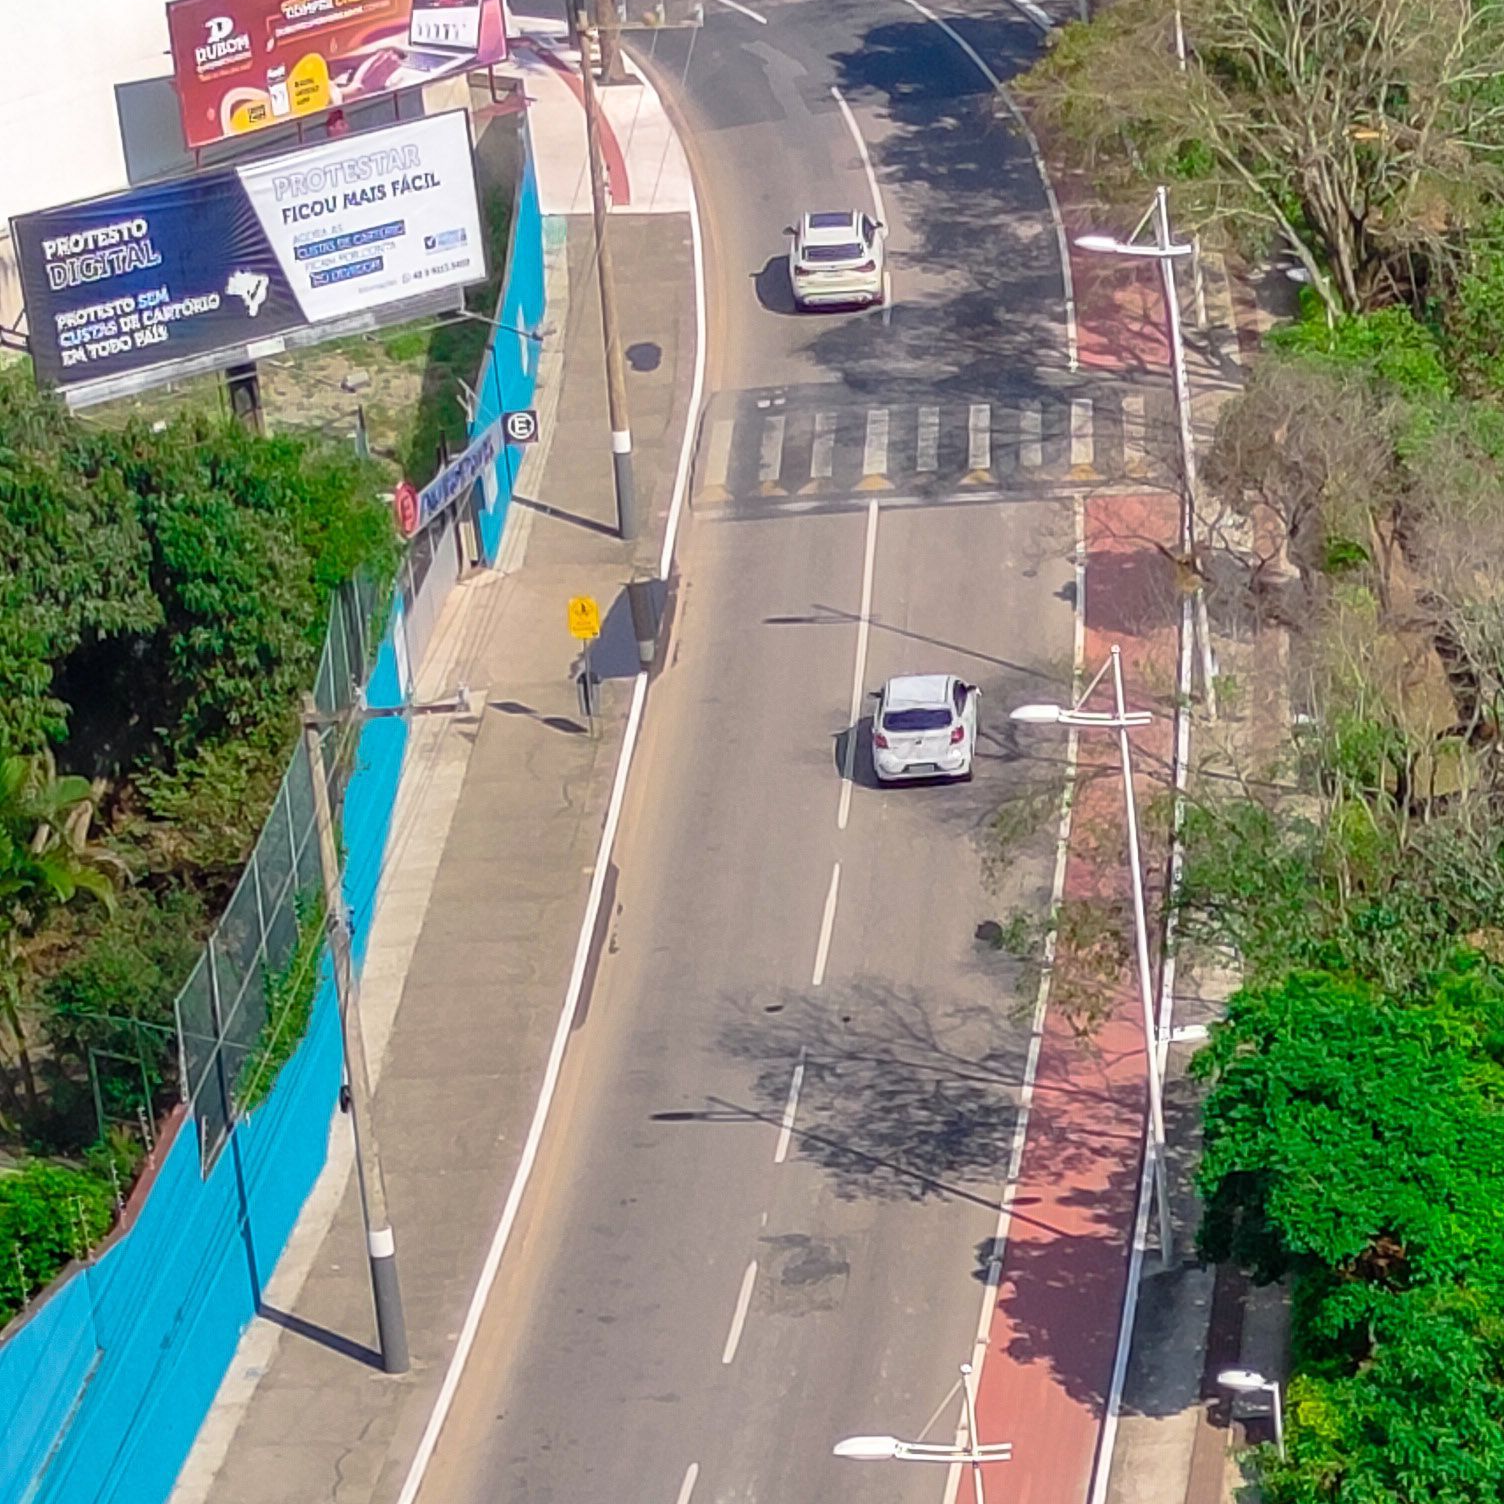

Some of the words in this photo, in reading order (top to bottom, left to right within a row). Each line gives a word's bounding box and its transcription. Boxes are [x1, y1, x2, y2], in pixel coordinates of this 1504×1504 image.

[273, 144, 421, 202] PROTESTAR
[282, 196, 337, 225] FICOU
[344, 184, 387, 209] MAIS
[391, 173, 441, 197] FÁCIL
[42, 218, 148, 260] PROTESTO
[46, 240, 162, 290] DIGITAL
[55, 297, 135, 332] PROTESTO
[138, 285, 170, 309] SEM
[60, 321, 117, 347] CUSTAS
[120, 315, 140, 332] DE
[143, 294, 221, 325] CARTÓRIO
[62, 348, 87, 366] EM
[86, 335, 132, 359] TODO
